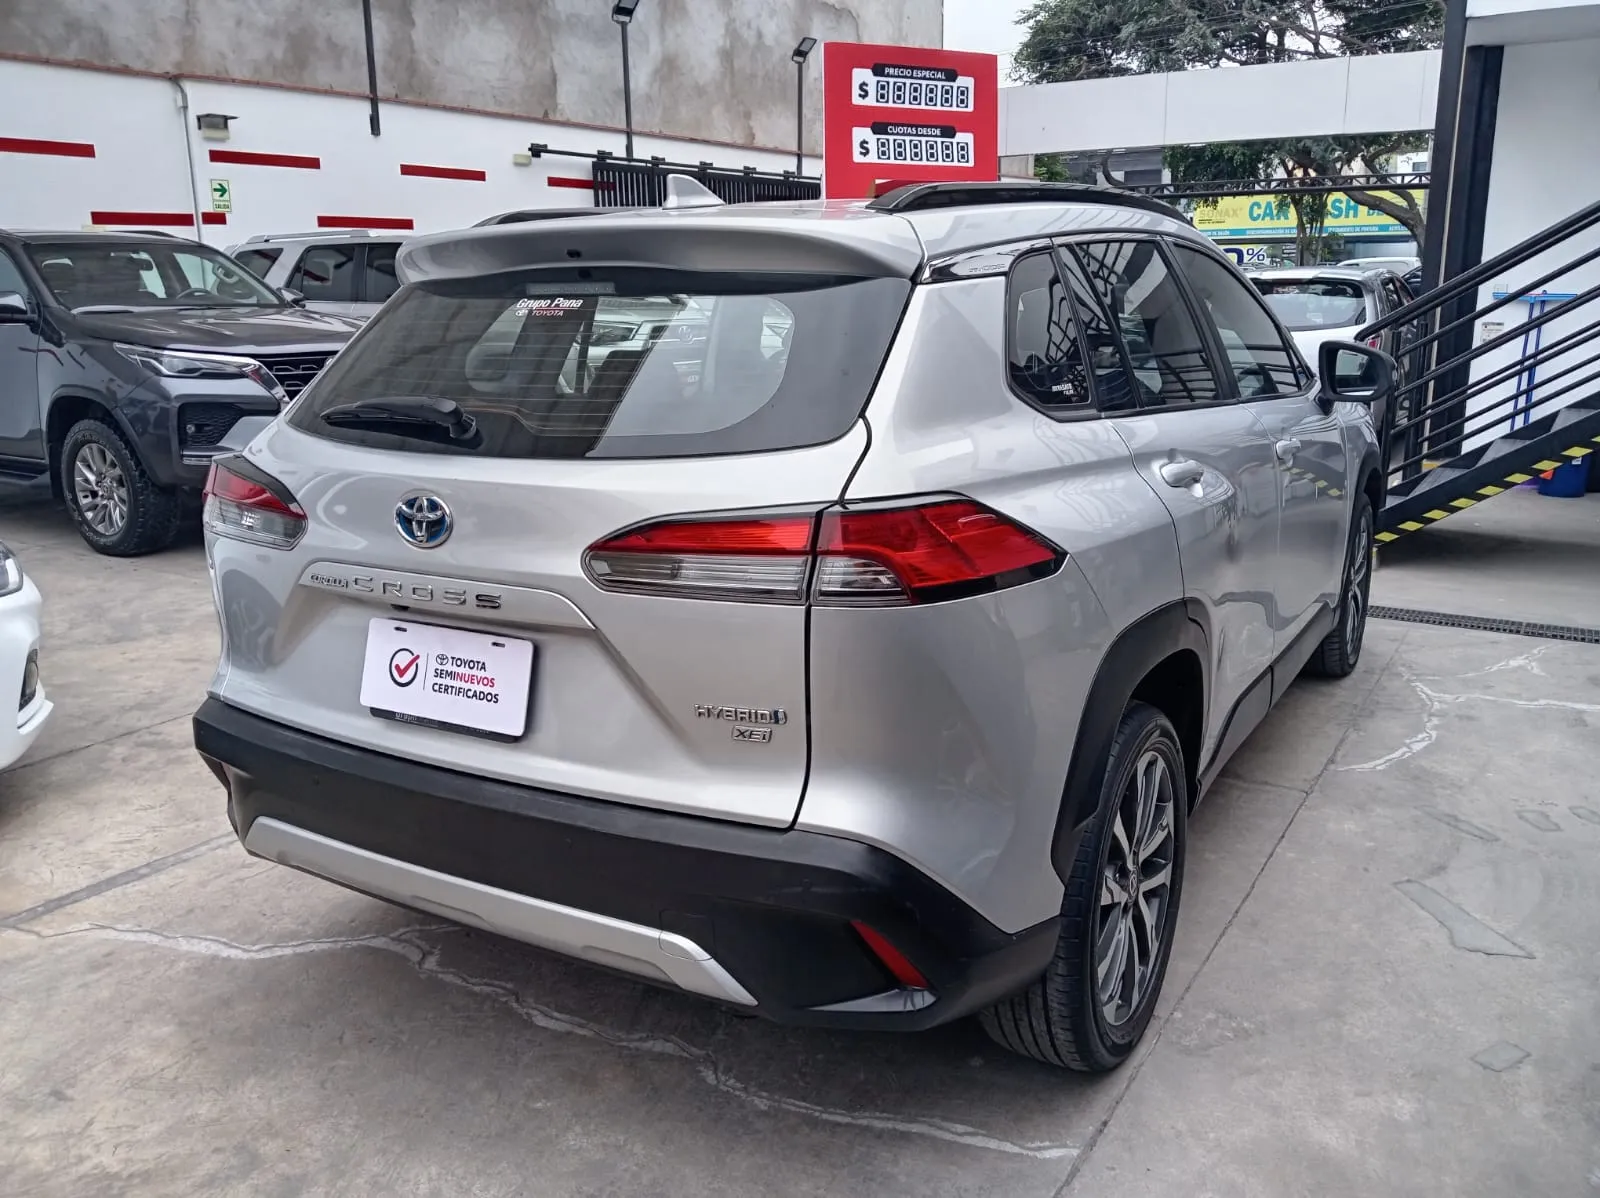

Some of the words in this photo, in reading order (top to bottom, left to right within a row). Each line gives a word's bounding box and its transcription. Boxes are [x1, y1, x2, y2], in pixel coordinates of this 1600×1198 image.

[884, 67, 912, 77] PRECIO
[913, 69, 946, 79] ESPECIAL
[858, 81, 869, 100] $
[887, 126, 917, 135] CUOTAS
[918, 127, 941, 136] DESDE
[859, 139, 870, 157] $
[516, 298, 551, 310] Grupo
[552, 297, 583, 308] Pana
[354, 575, 502, 609] CROSS
[450, 656, 487, 672] TOYOTA
[433, 668, 496, 688] SEMINUEVOS
[432, 682, 500, 704] CERTIFICADOS
[695, 704, 772, 724] HYBRID
